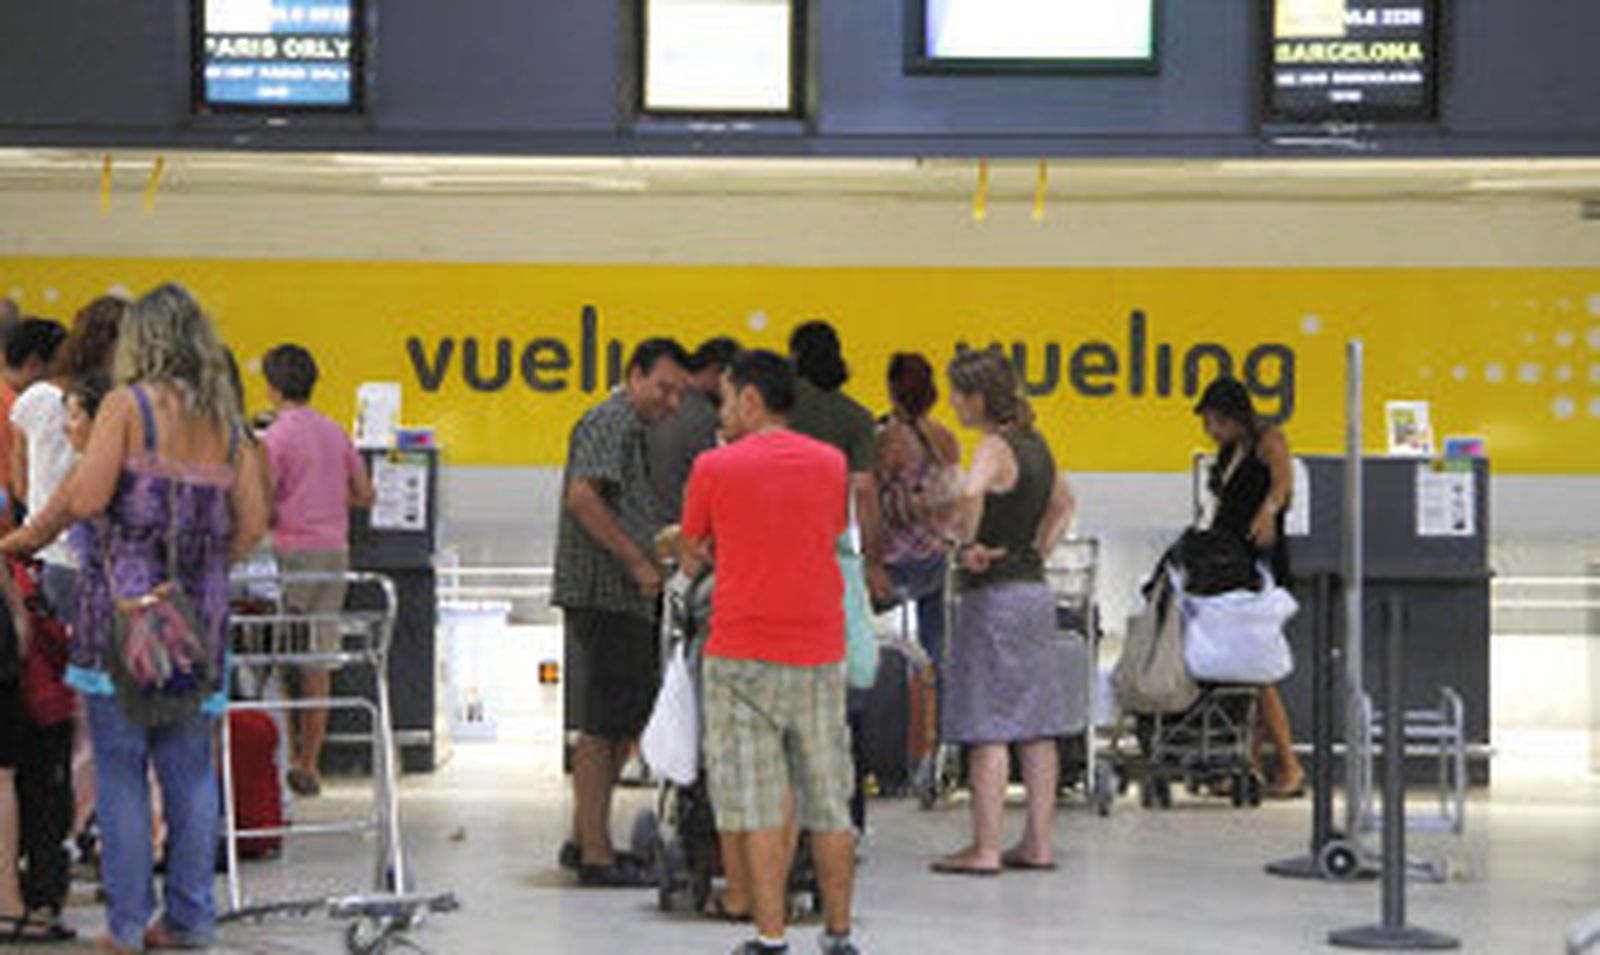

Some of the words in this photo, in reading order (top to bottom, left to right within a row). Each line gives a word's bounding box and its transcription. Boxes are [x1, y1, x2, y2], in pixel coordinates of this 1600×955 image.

[283, 37, 349, 58] ORLY
[1275, 43, 1424, 63] BARCELONA
[406, 305, 624, 393] vueli
[954, 310, 1296, 428] ueling
